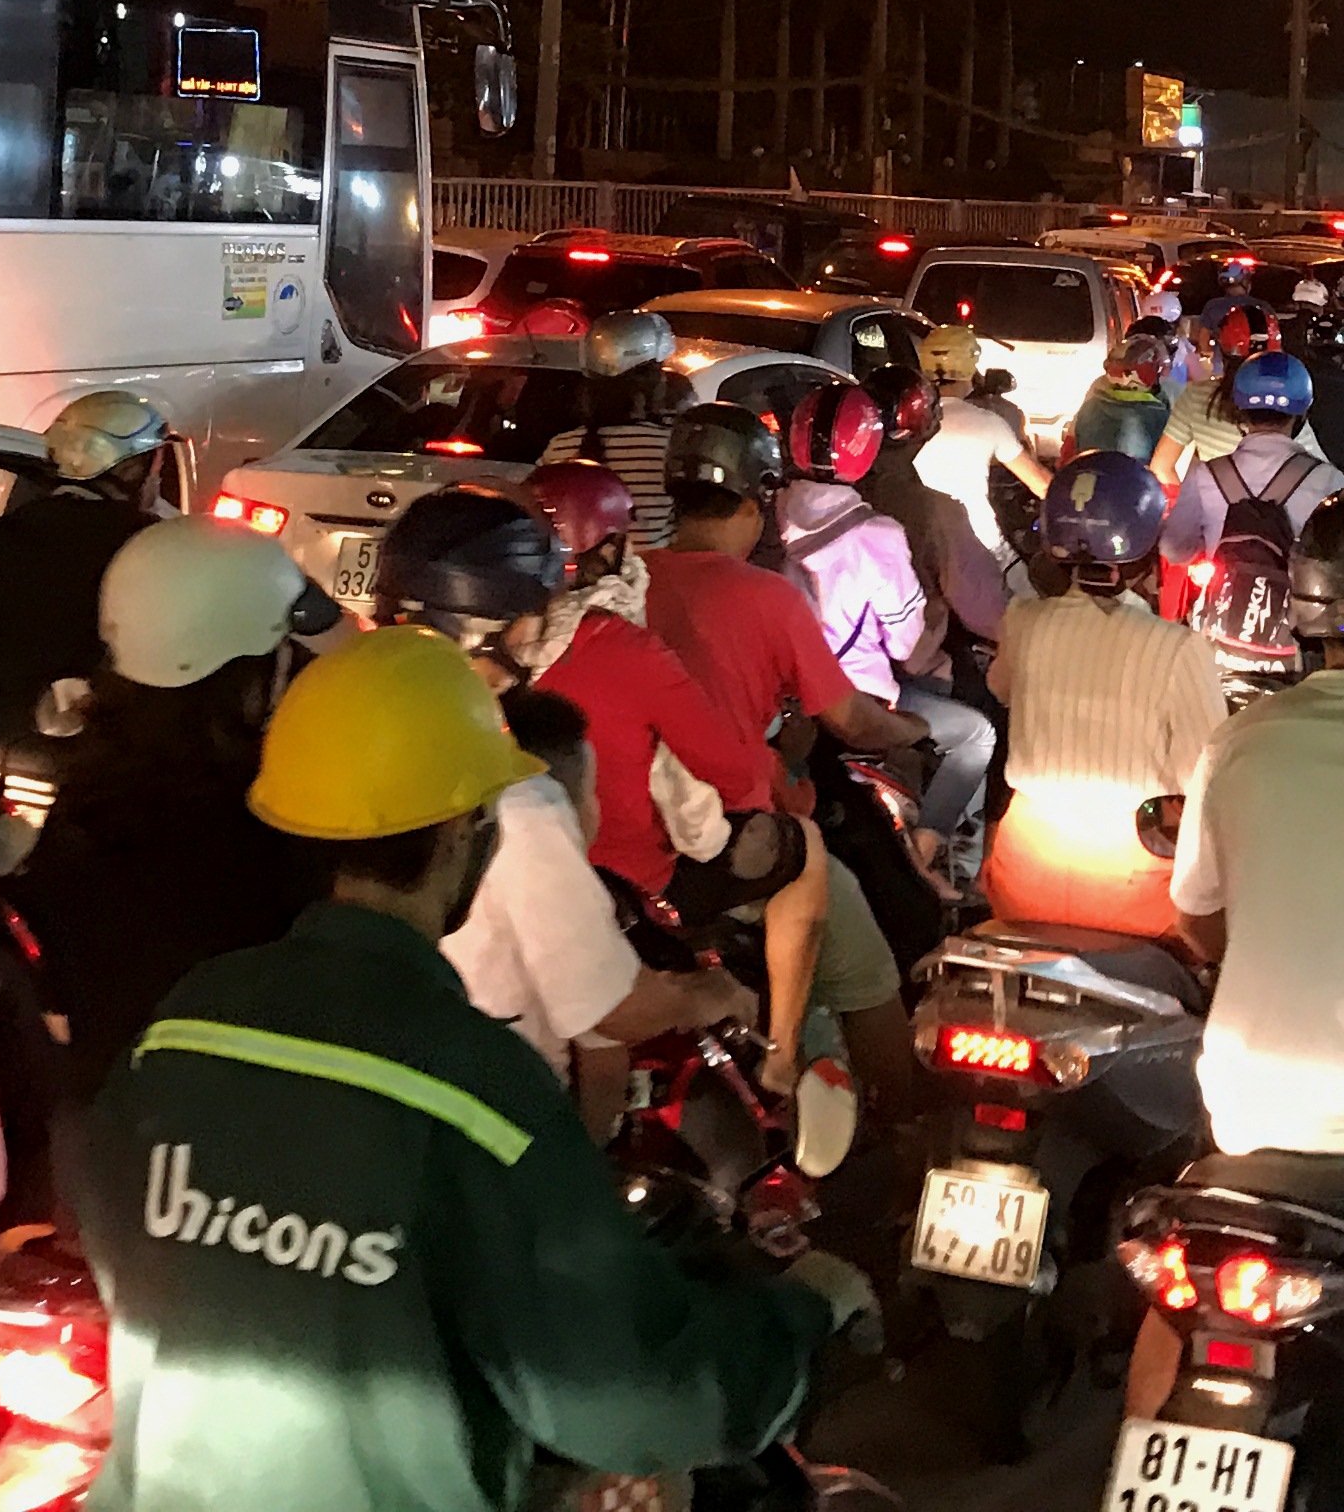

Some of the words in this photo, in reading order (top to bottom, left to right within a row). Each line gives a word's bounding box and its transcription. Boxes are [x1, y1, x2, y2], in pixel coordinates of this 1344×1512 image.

[1238, 575, 1269, 643] NOKIA
[144, 1142, 401, 1286] Unicons
[1139, 1431, 1263, 1501] 81-H1
